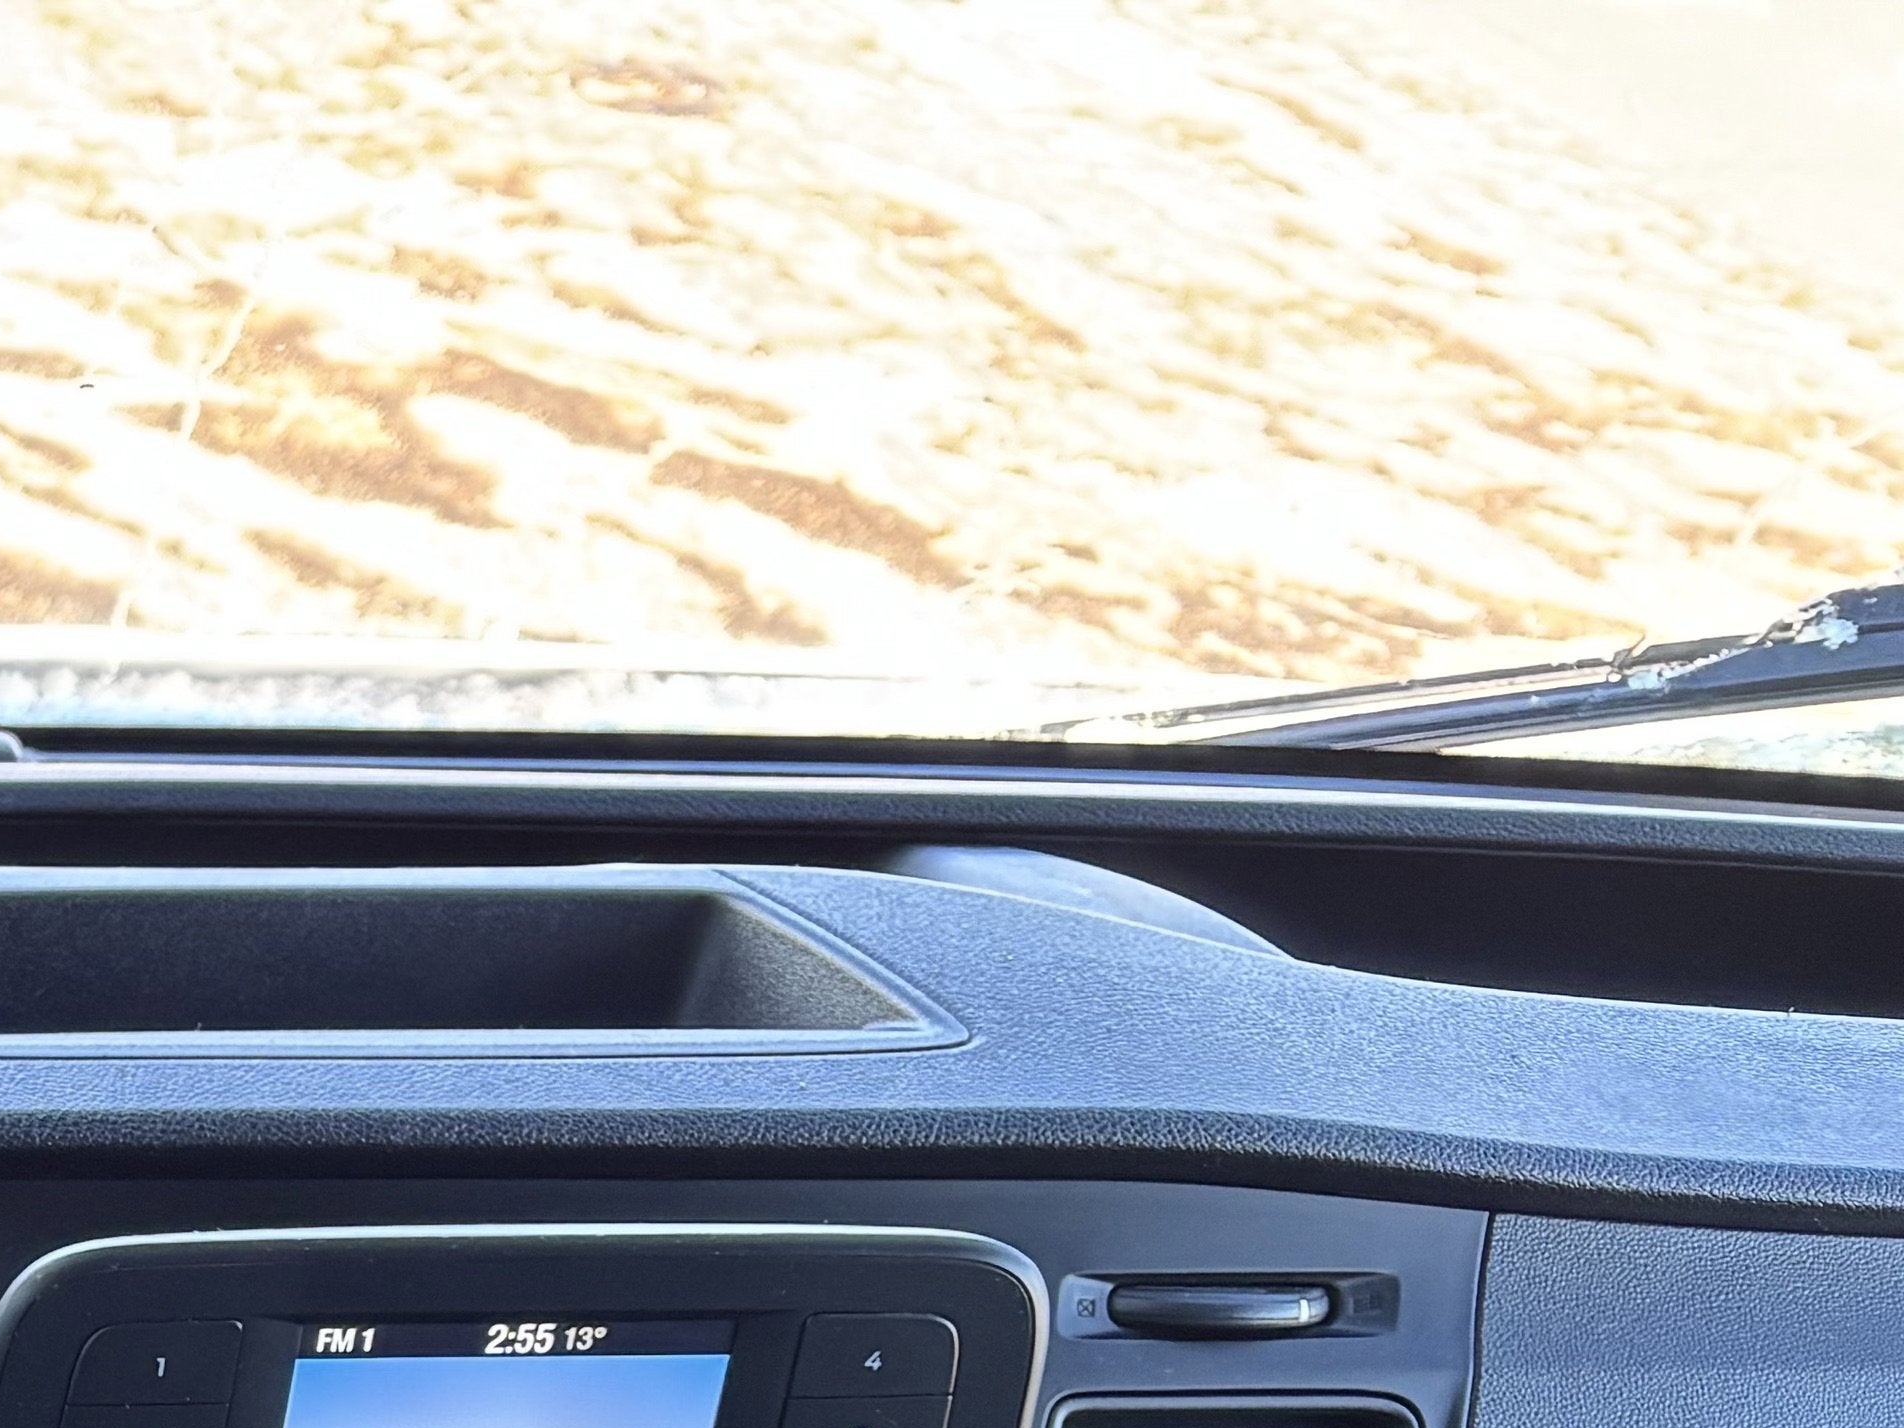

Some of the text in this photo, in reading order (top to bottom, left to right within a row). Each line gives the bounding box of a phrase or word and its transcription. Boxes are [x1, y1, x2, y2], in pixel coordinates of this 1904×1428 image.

[316, 1327, 376, 1353] FM 1
[485, 1323, 608, 1355] 2:55 13°
[156, 1357, 166, 1377] 1
[864, 1350, 882, 1371] 4
